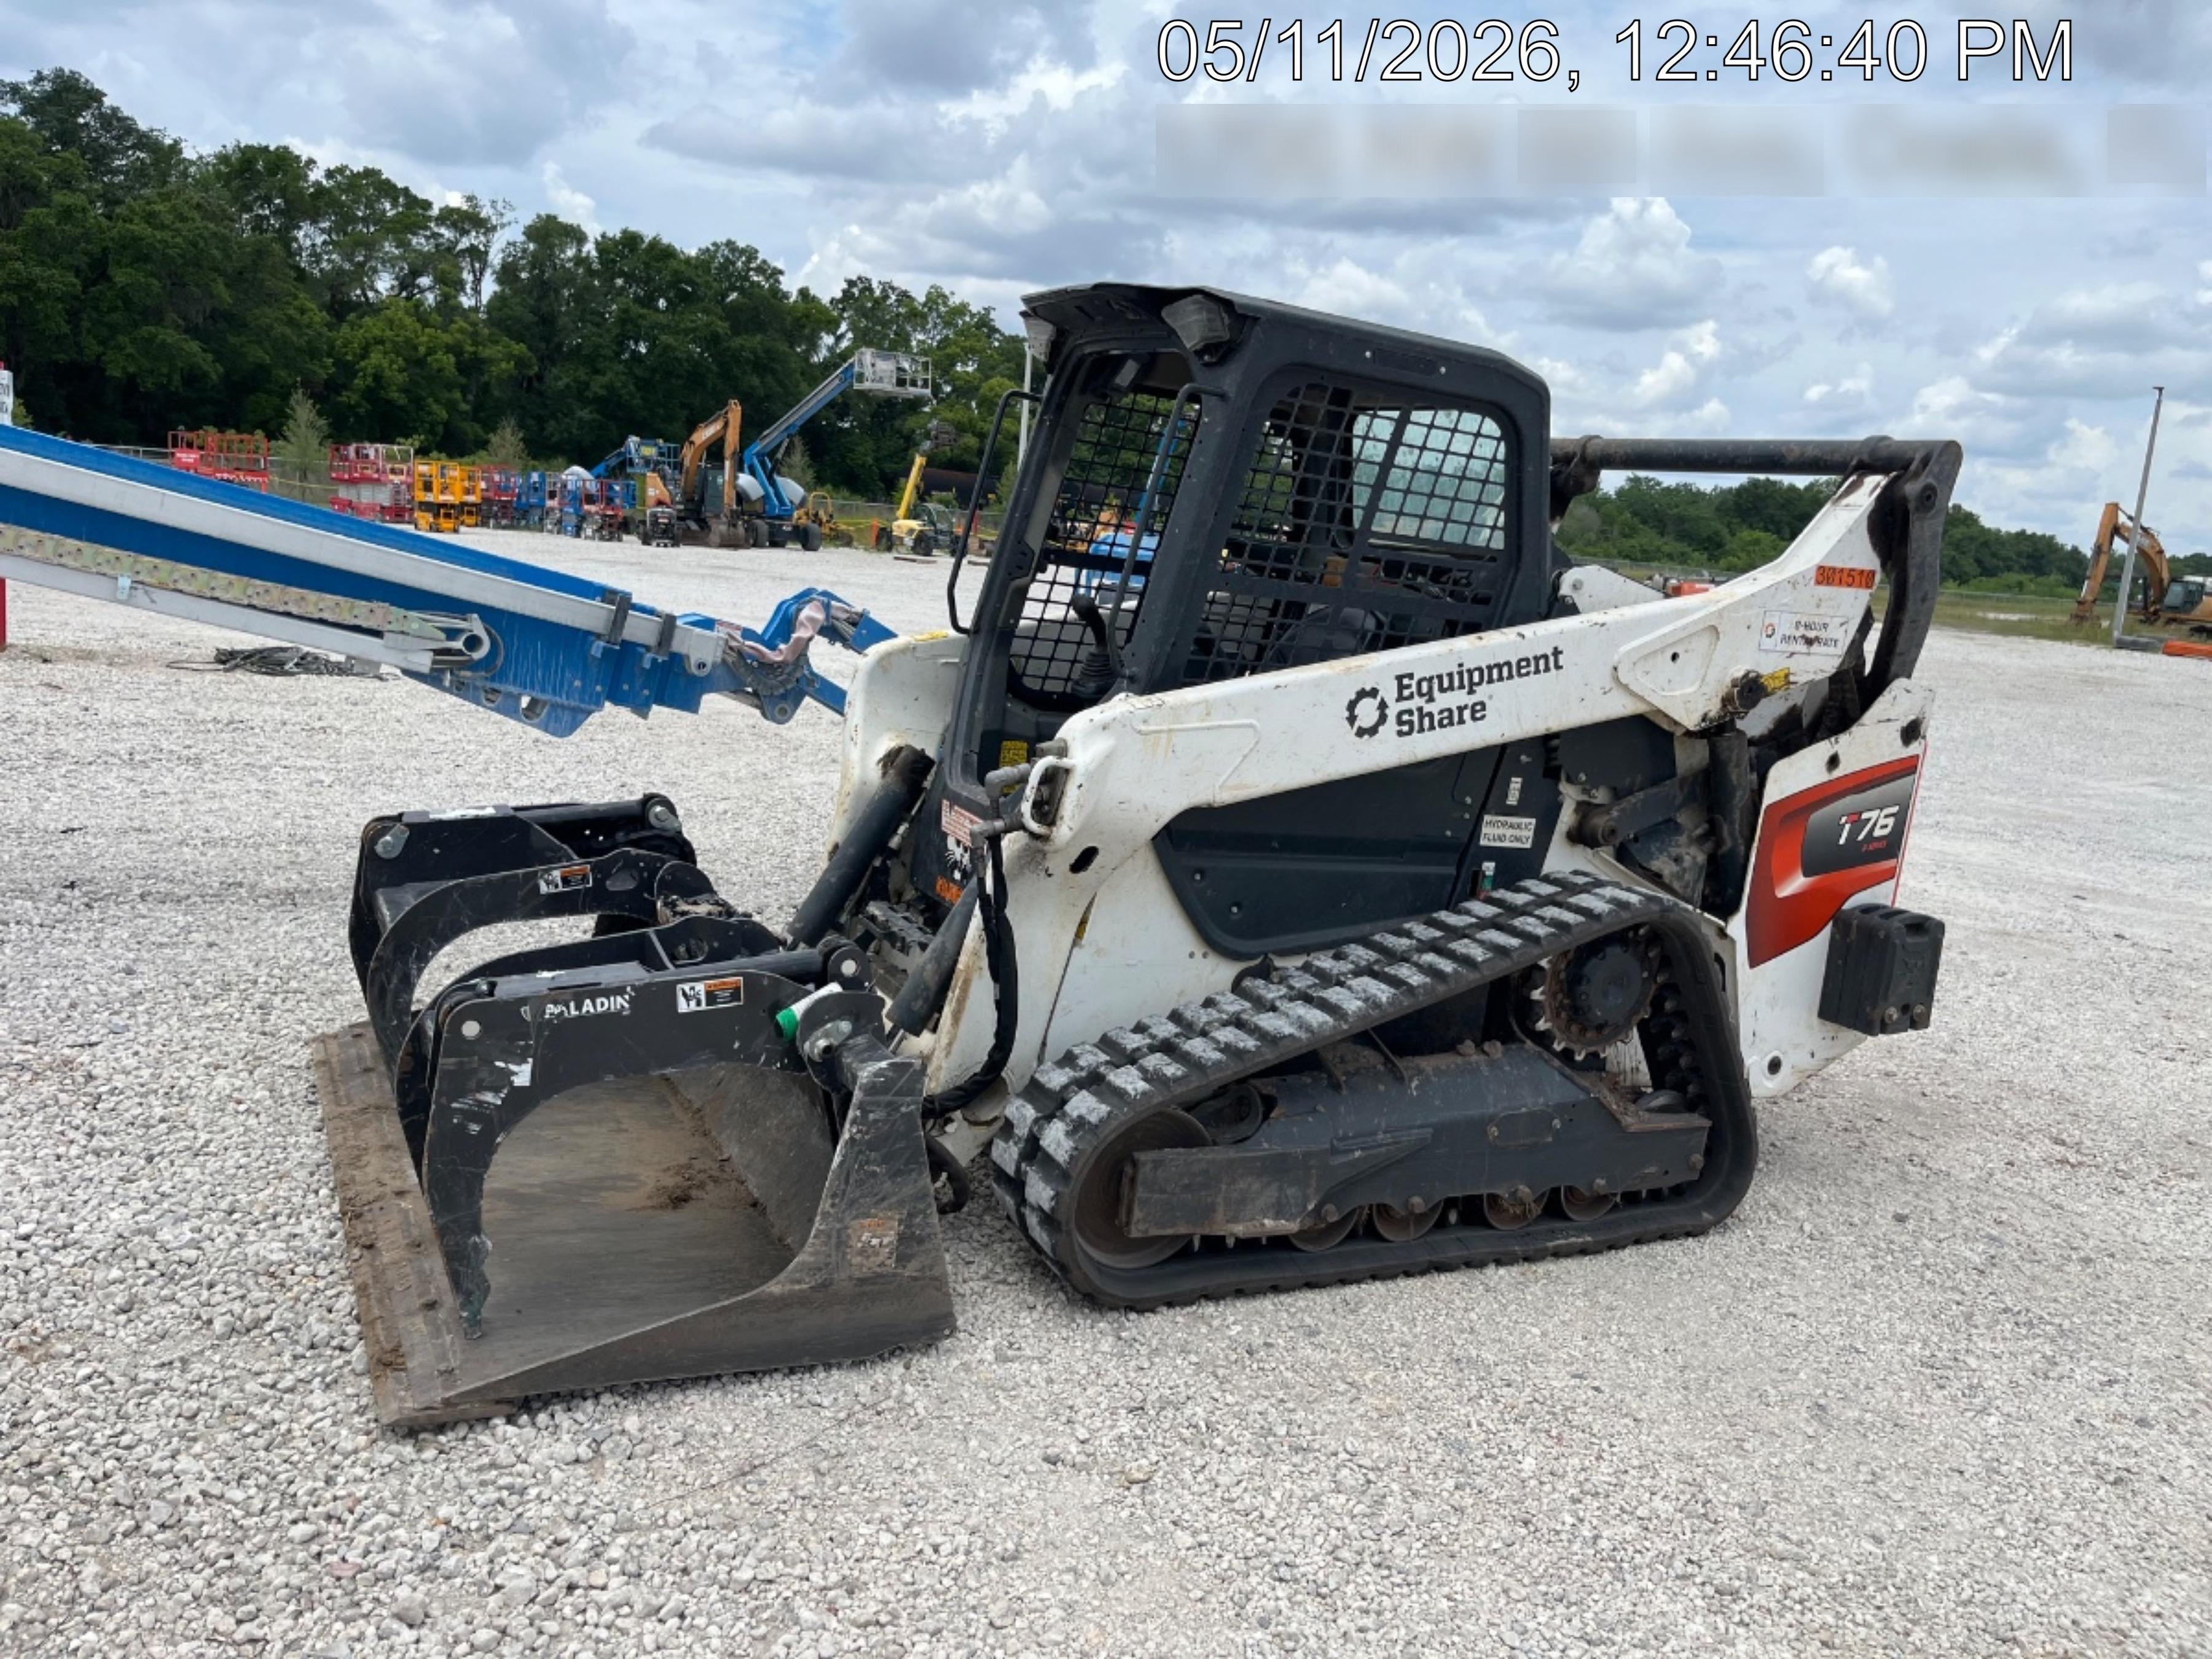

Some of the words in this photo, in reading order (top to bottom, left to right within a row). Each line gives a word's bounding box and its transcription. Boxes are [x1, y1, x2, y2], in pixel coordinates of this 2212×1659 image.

[1816, 566, 1876, 589] 301510
[1395, 646, 1564, 704] Equipment
[1395, 700, 1487, 737] Share
[1483, 833, 1506, 843] FLUID
[1508, 835, 1531, 845] ONLY
[1484, 820, 1533, 831] HYDRAULIC
[1838, 805, 1900, 845] T76
